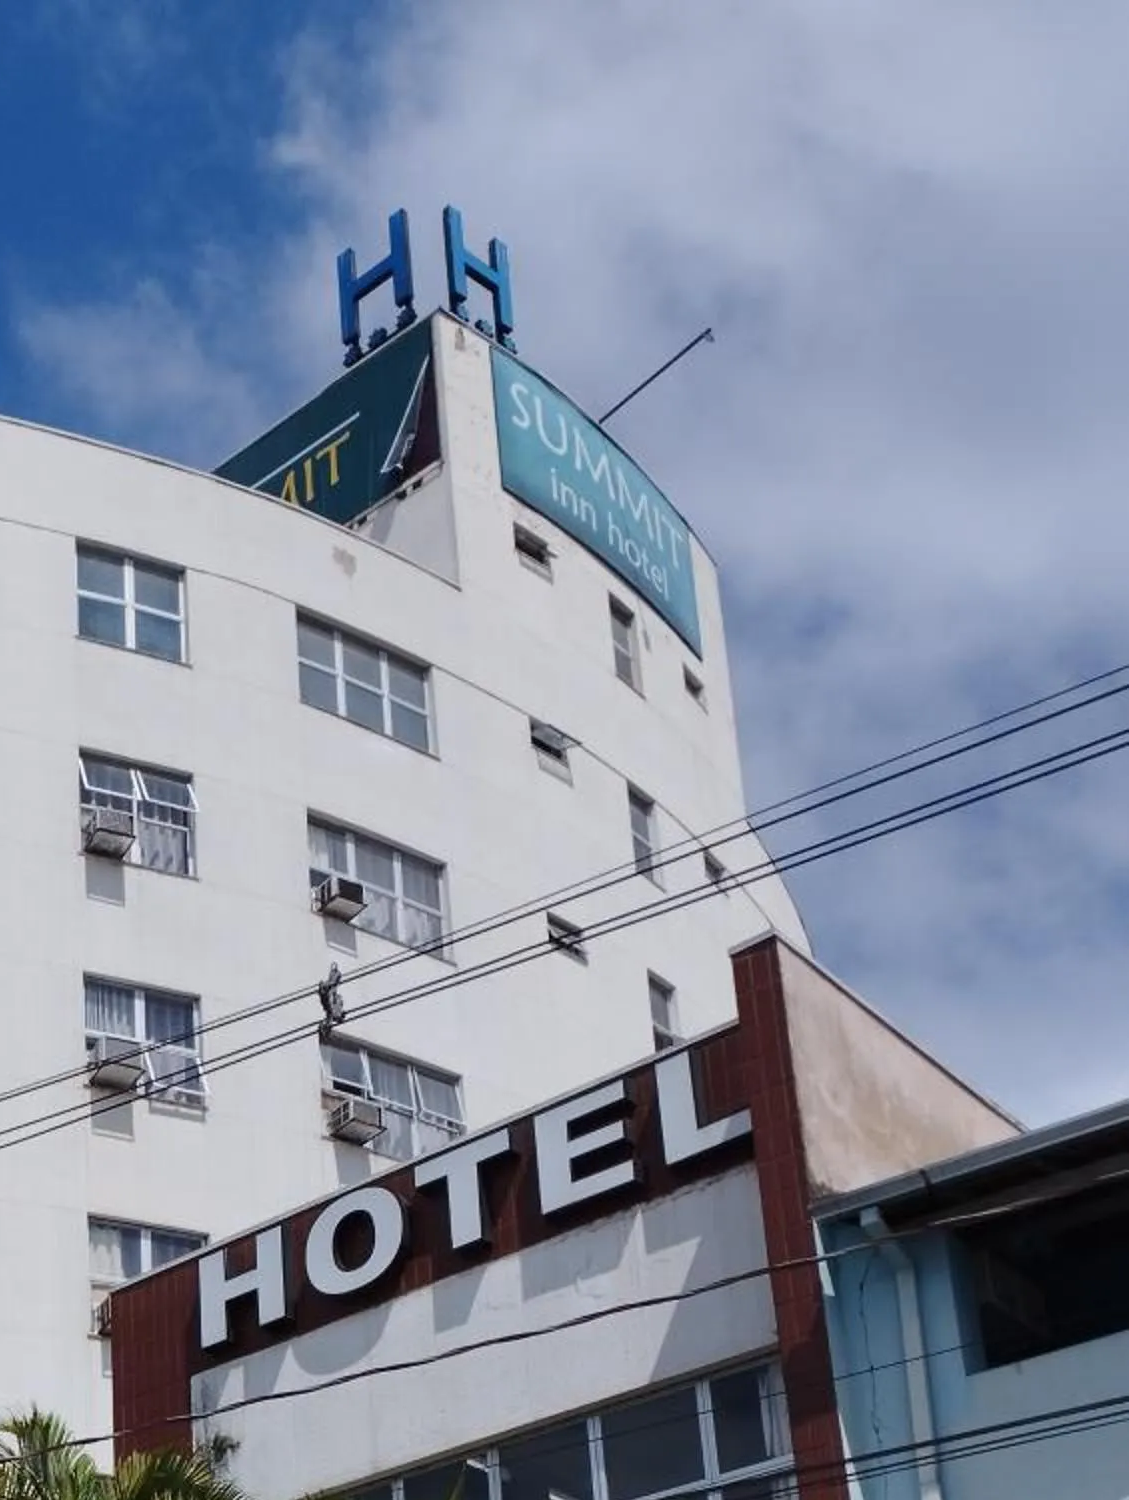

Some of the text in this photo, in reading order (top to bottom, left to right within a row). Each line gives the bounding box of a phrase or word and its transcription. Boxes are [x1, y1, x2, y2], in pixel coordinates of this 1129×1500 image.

[509, 382, 684, 570] SUMMIT
[549, 466, 670, 602] inn hotel
[197, 1048, 755, 1352] HOTEL
